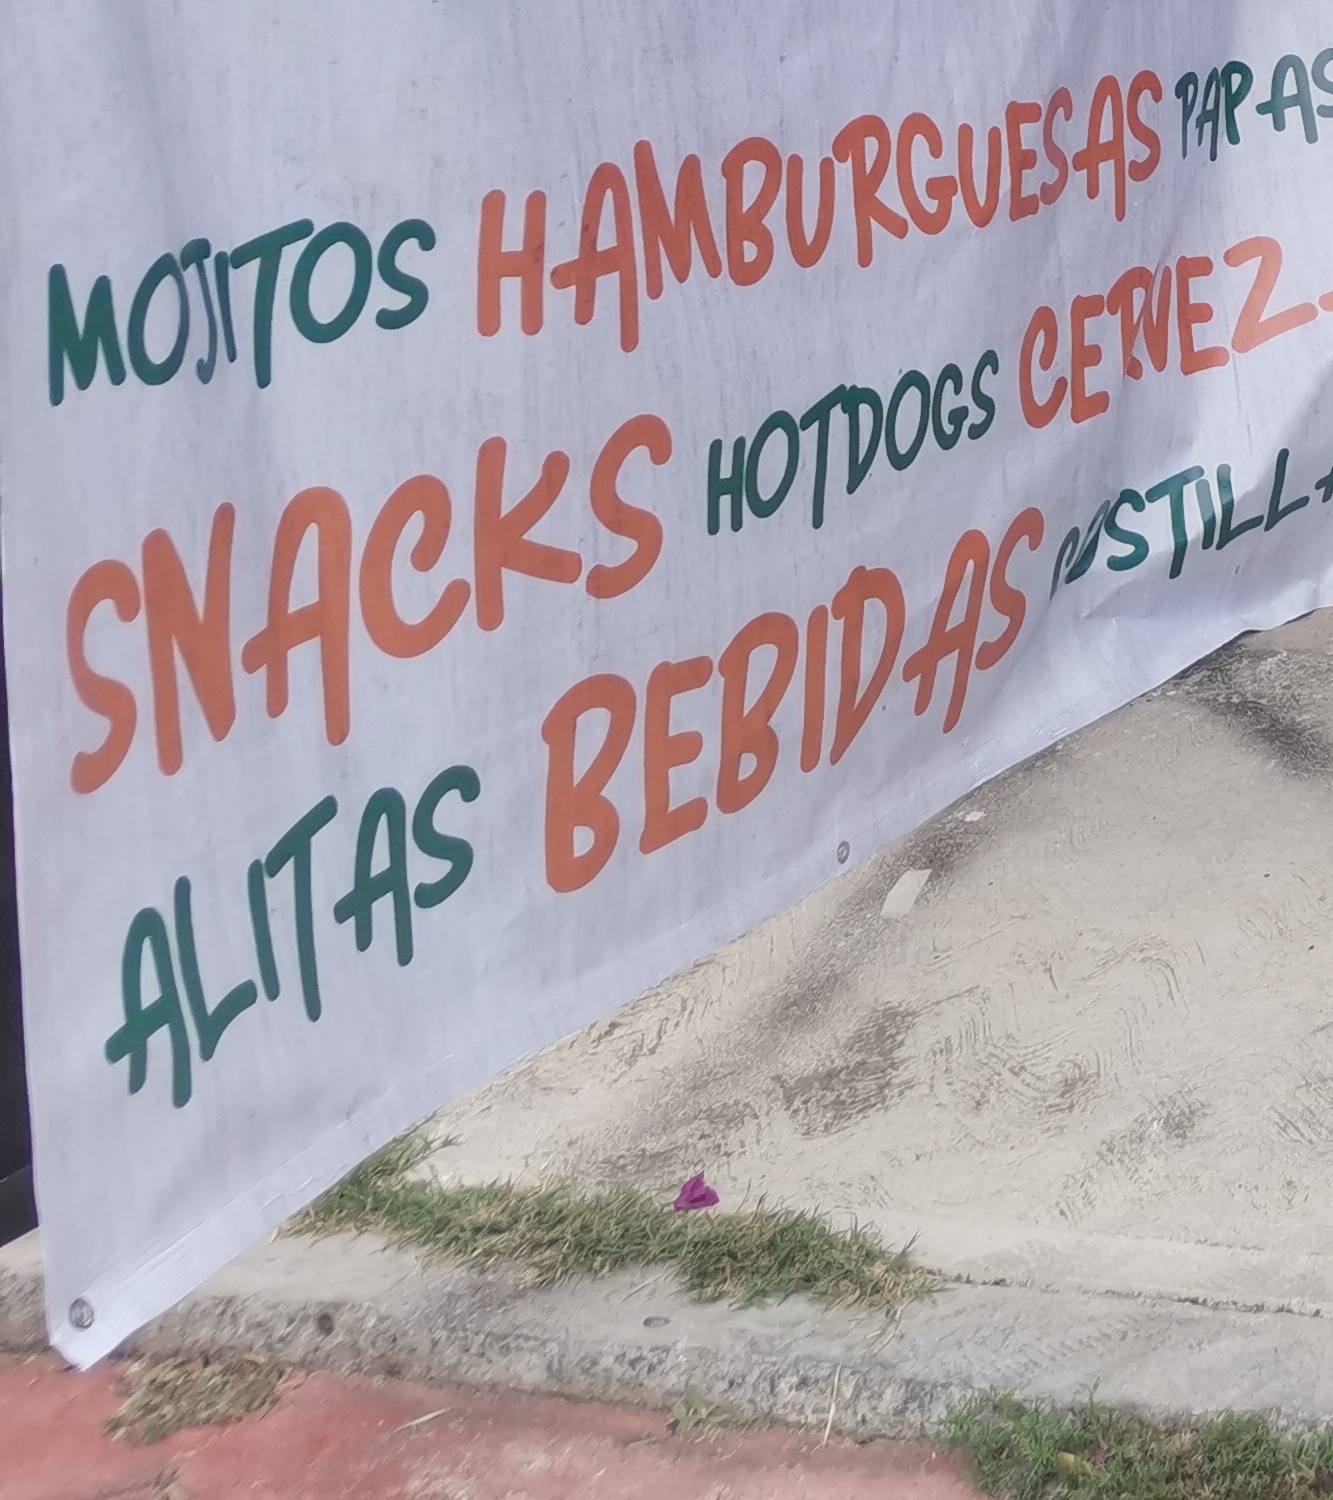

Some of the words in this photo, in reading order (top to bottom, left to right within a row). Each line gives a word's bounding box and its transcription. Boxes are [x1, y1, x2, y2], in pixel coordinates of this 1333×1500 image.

[47, 216, 435, 405] MOJITOS
[475, 69, 1163, 352] HAMBURGUESAS
[65, 412, 672, 794] SNACKS
[706, 348, 1000, 536] HOTDOGS
[106, 763, 481, 1106] ALITAS
[541, 506, 1044, 894] BEBIDAS
